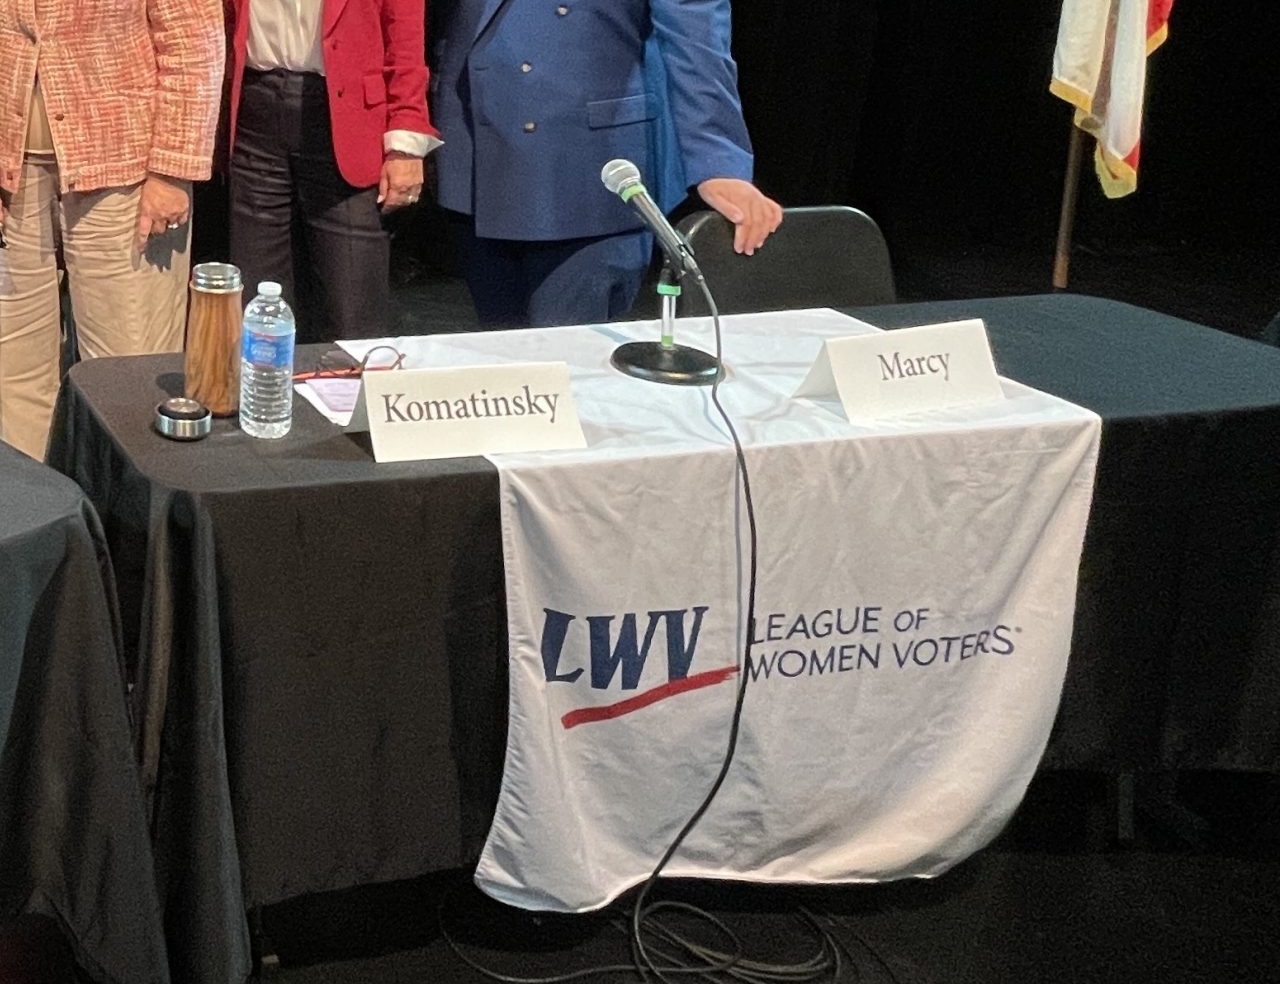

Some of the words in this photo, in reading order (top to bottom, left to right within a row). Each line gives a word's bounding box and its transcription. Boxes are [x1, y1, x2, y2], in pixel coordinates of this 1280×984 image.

[877, 352, 950, 381] Marcy
[382, 385, 559, 423] Komatinsky
[751, 606, 882, 645] LEAGUE
[893, 608, 930, 633] OF
[540, 606, 709, 690] LWV
[748, 643, 881, 683] WOMEN
[892, 624, 1017, 668] VOTERS
